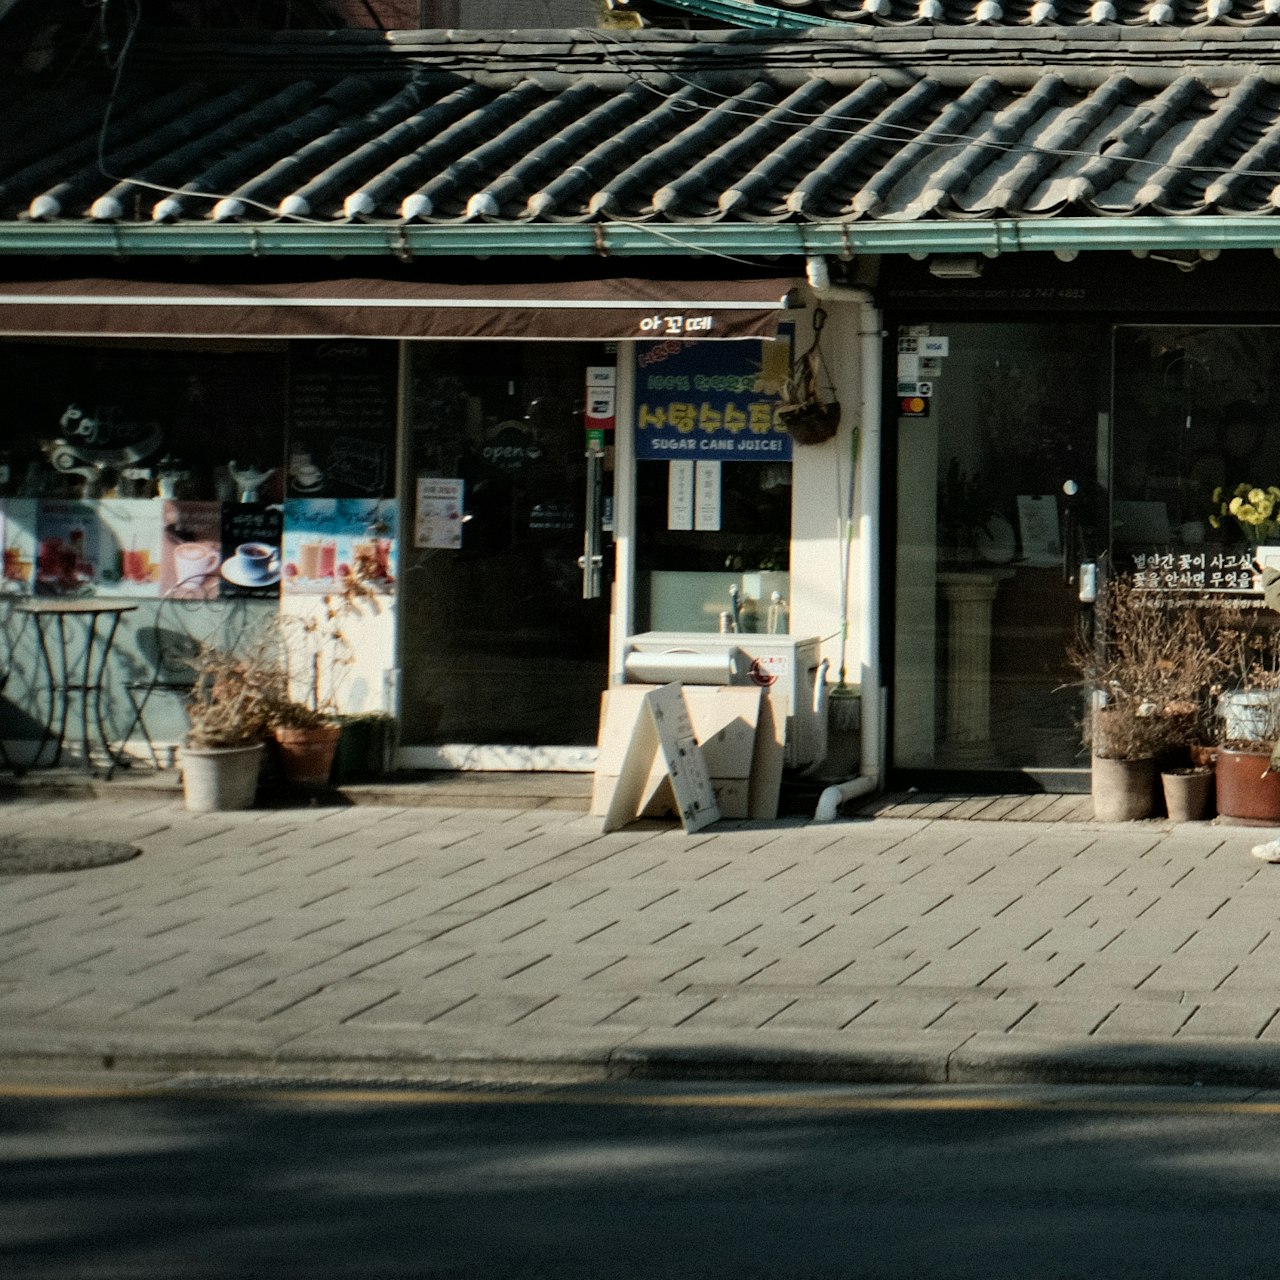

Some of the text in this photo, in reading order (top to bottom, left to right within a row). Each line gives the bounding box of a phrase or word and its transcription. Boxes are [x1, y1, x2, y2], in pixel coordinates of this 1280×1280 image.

[651, 439, 782, 451] SUGAR CANE JUICE!
[482, 446, 525, 463] open
